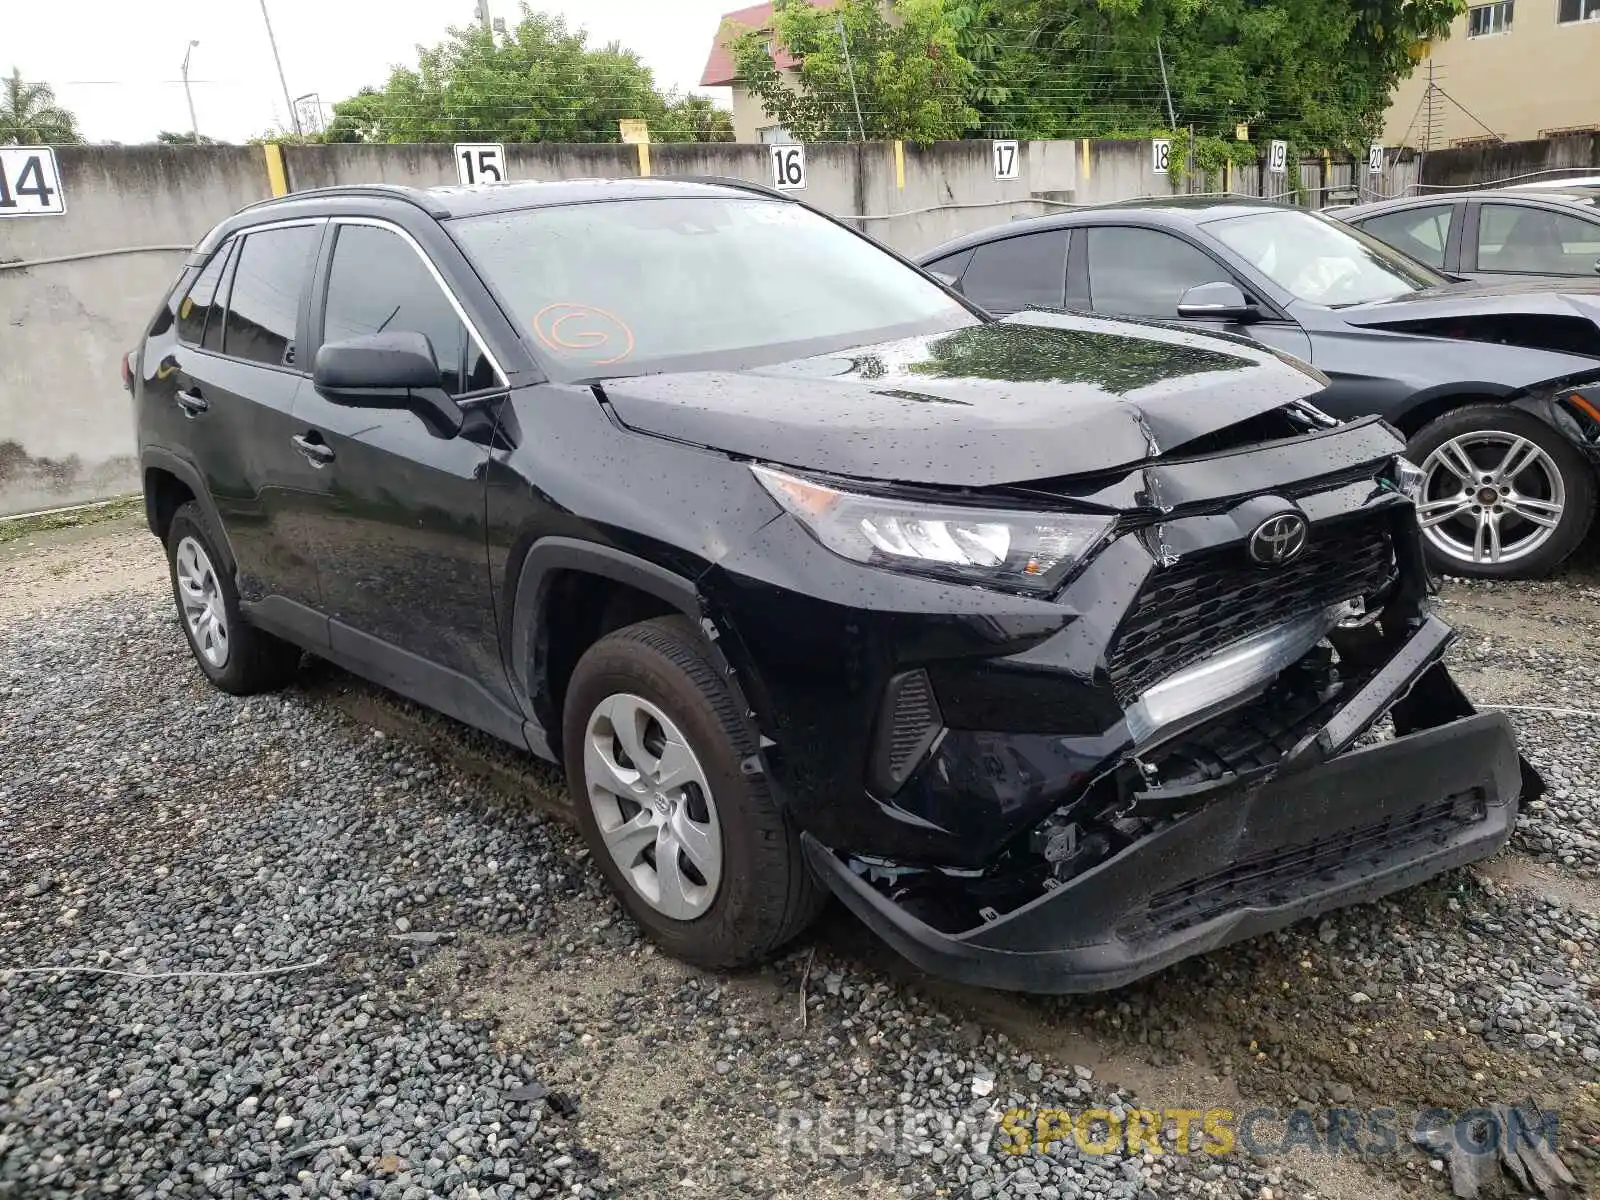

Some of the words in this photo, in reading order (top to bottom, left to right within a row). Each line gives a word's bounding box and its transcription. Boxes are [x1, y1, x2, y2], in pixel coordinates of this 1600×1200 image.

[462, 151, 501, 184] 15
[775, 150, 802, 184] 16
[996, 145, 1015, 175] 17
[1155, 144, 1169, 169] 18
[1272, 145, 1284, 167] 19
[1370, 149, 1382, 168] 20
